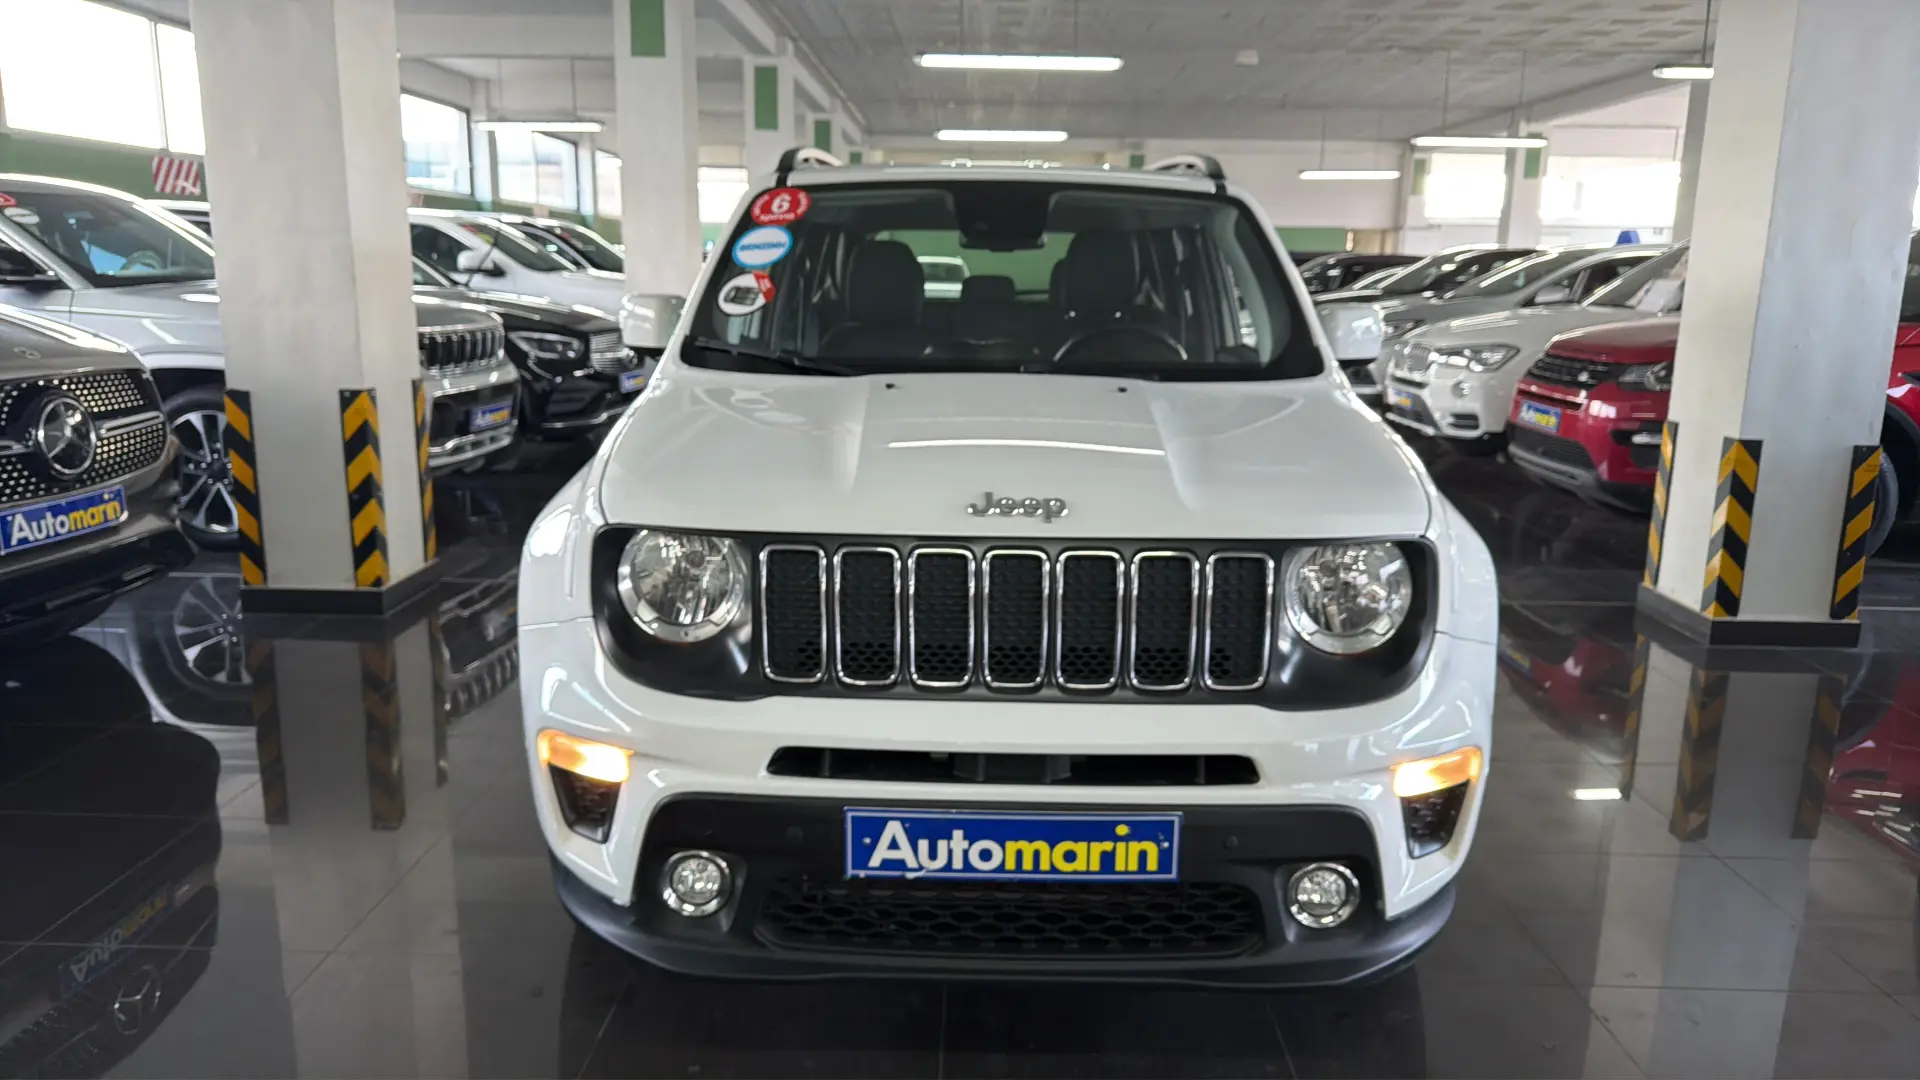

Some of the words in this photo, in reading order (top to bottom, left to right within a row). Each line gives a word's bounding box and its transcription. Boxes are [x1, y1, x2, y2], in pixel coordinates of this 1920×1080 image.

[771, 193, 792, 214] 6
[11, 493, 121, 546] Automarin
[967, 492, 1068, 524] Jeep
[867, 820, 1159, 872] Automarin
